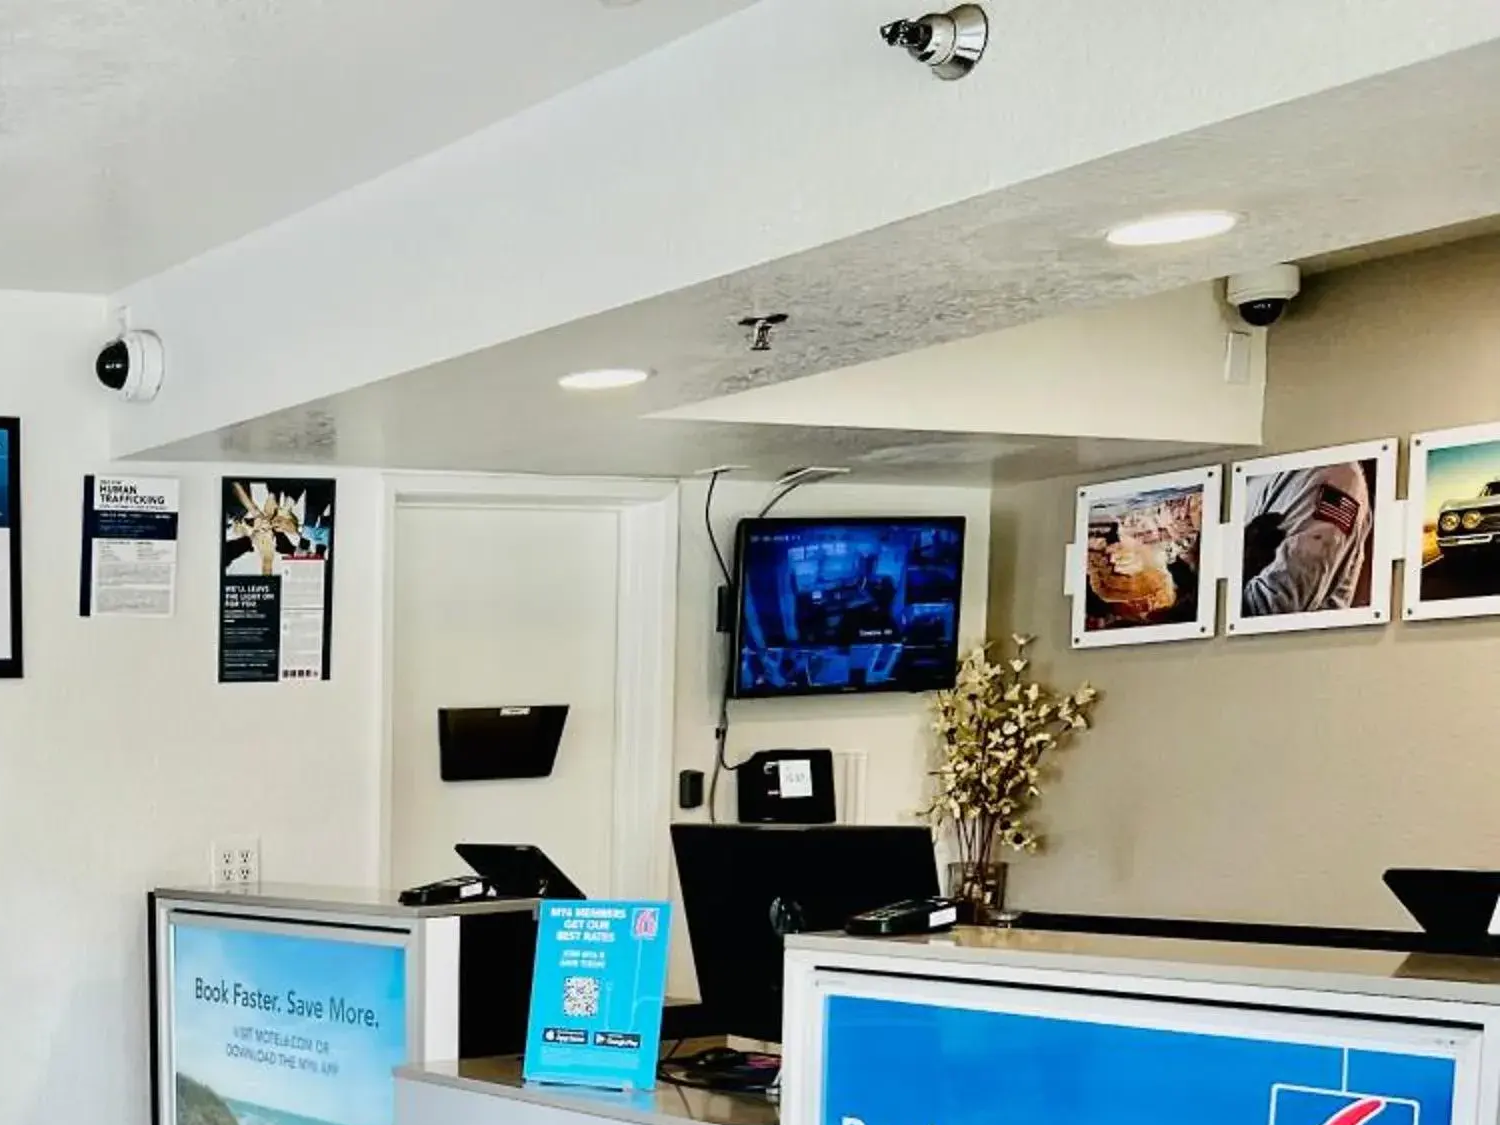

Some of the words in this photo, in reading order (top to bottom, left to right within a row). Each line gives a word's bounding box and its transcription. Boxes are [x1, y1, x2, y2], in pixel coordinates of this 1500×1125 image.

[100, 495, 165, 504] TRAFFICKING
[195, 977, 229, 1005] Book
[233, 982, 282, 1014] Faster.
[287, 989, 323, 1019] Save
[329, 995, 380, 1030] More.
